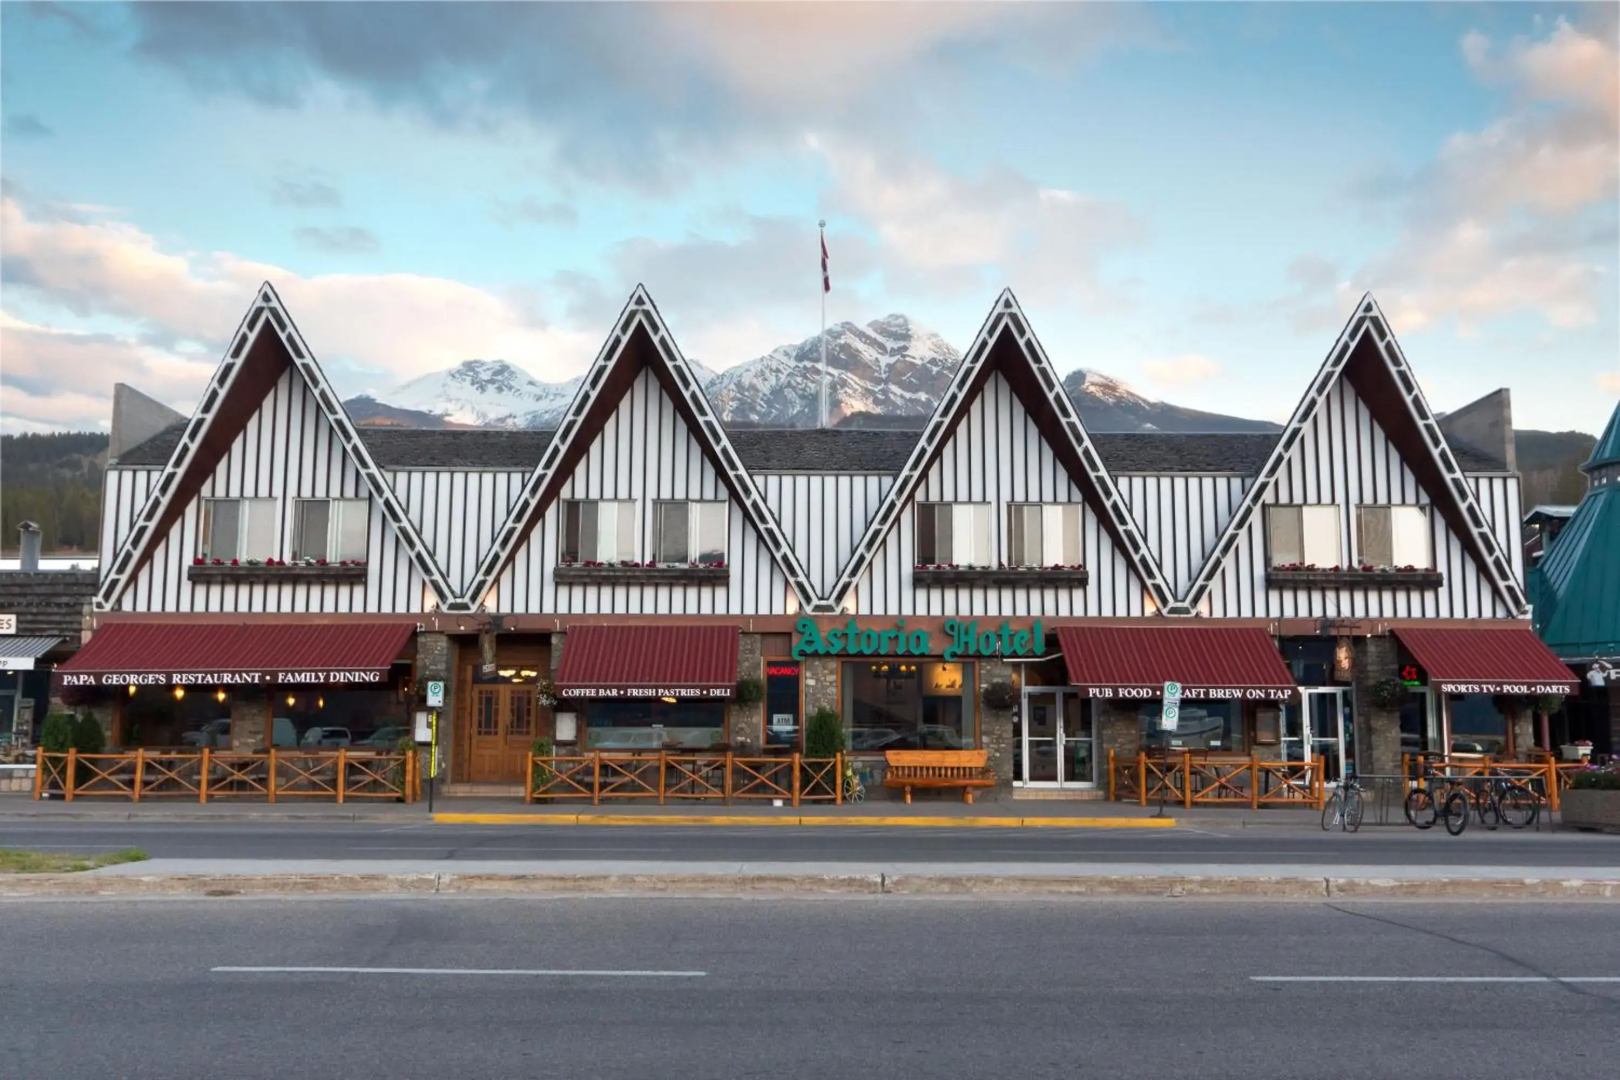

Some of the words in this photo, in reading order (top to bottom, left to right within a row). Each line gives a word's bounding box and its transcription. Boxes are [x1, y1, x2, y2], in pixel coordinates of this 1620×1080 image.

[792, 616, 932, 660] Astoria
[943, 618, 1047, 661] Hotel
[767, 666, 799, 675] VACANCY
[62, 674, 96, 686] PAPA
[102, 673, 167, 685] GEORGE'S
[171, 672, 262, 685] RESTAURANT
[277, 671, 326, 684] FAMILY
[329, 671, 380, 683] DINING
[562, 688, 597, 697] COFFEE
[598, 688, 618, 696] BAR
[627, 688, 656, 697] FRESH
[658, 688, 701, 697] PASTRIES
[709, 688, 731, 697] DELI
[1088, 687, 1113, 698] PUB
[1118, 687, 1152, 698] FOOD
[1208, 688, 1244, 699] BREW
[1246, 688, 1265, 699] ON
[1267, 688, 1292, 699] TAP
[1441, 684, 1479, 693] SPORTS
[1481, 684, 1496, 693] TV
[1502, 684, 1530, 694] POOL
[1536, 684, 1571, 694] DARTS
